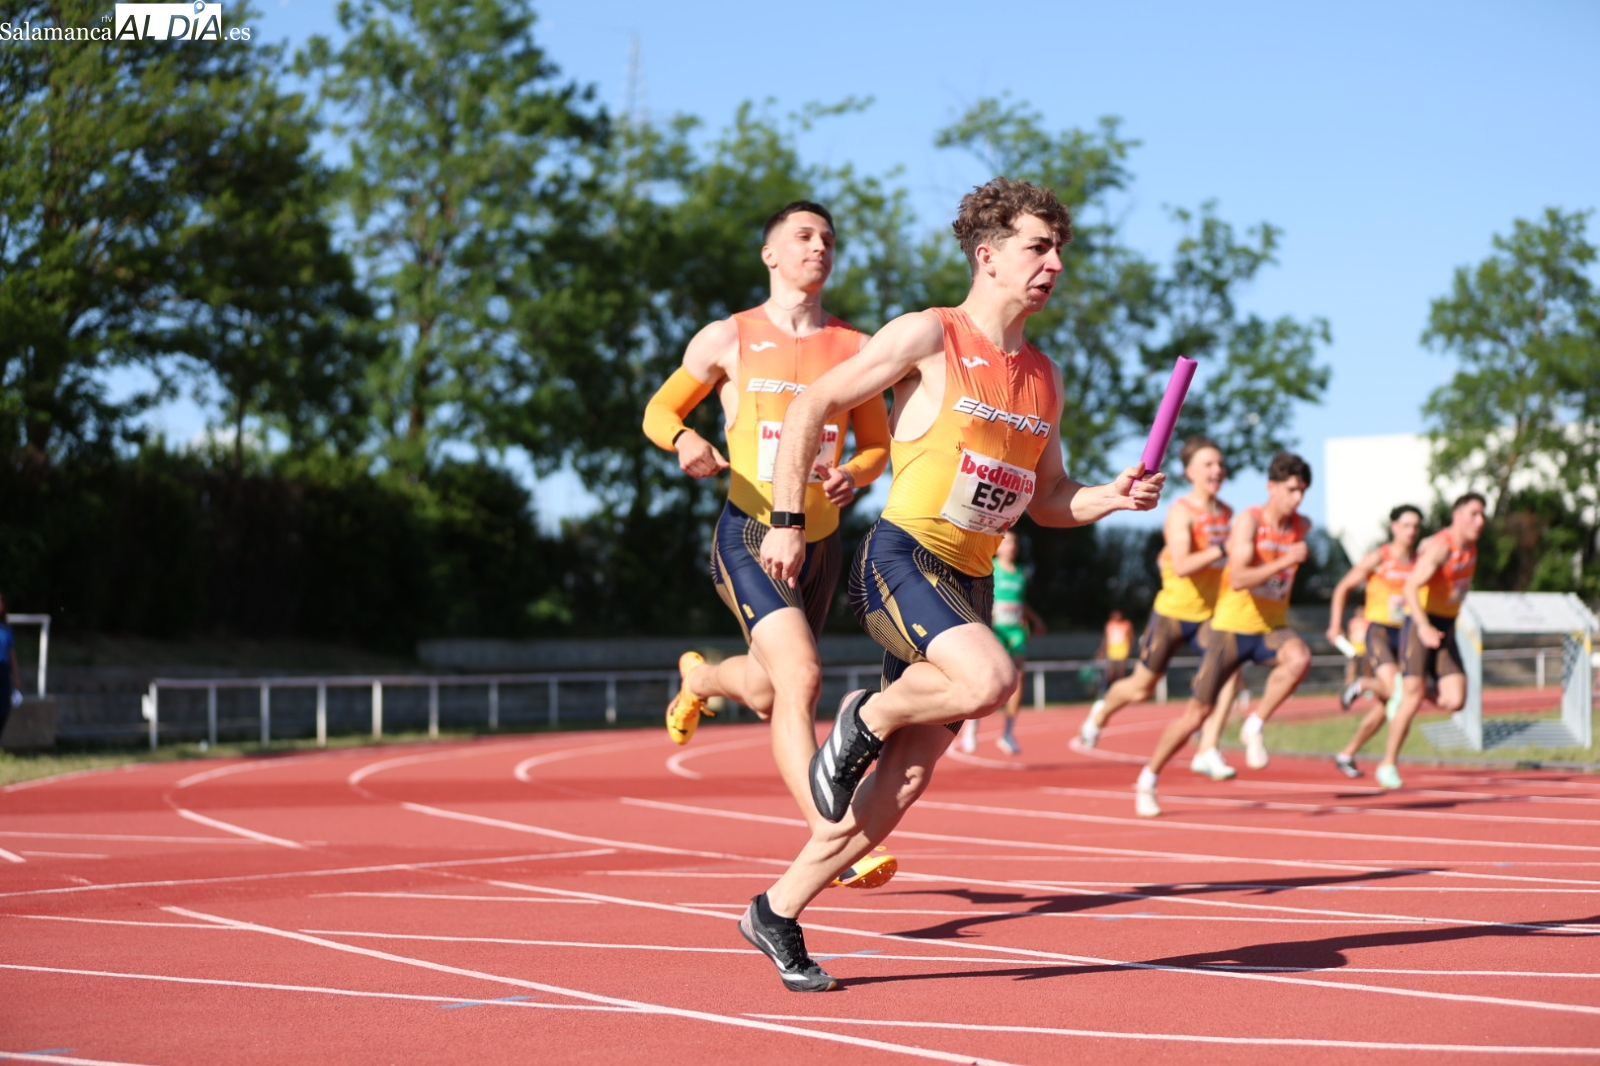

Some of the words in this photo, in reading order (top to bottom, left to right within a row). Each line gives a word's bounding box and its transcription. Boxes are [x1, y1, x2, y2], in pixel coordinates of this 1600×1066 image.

[953, 396, 1051, 438] ESPAÑA
[960, 454, 1034, 495] bedunia
[971, 481, 1017, 513] ESP
